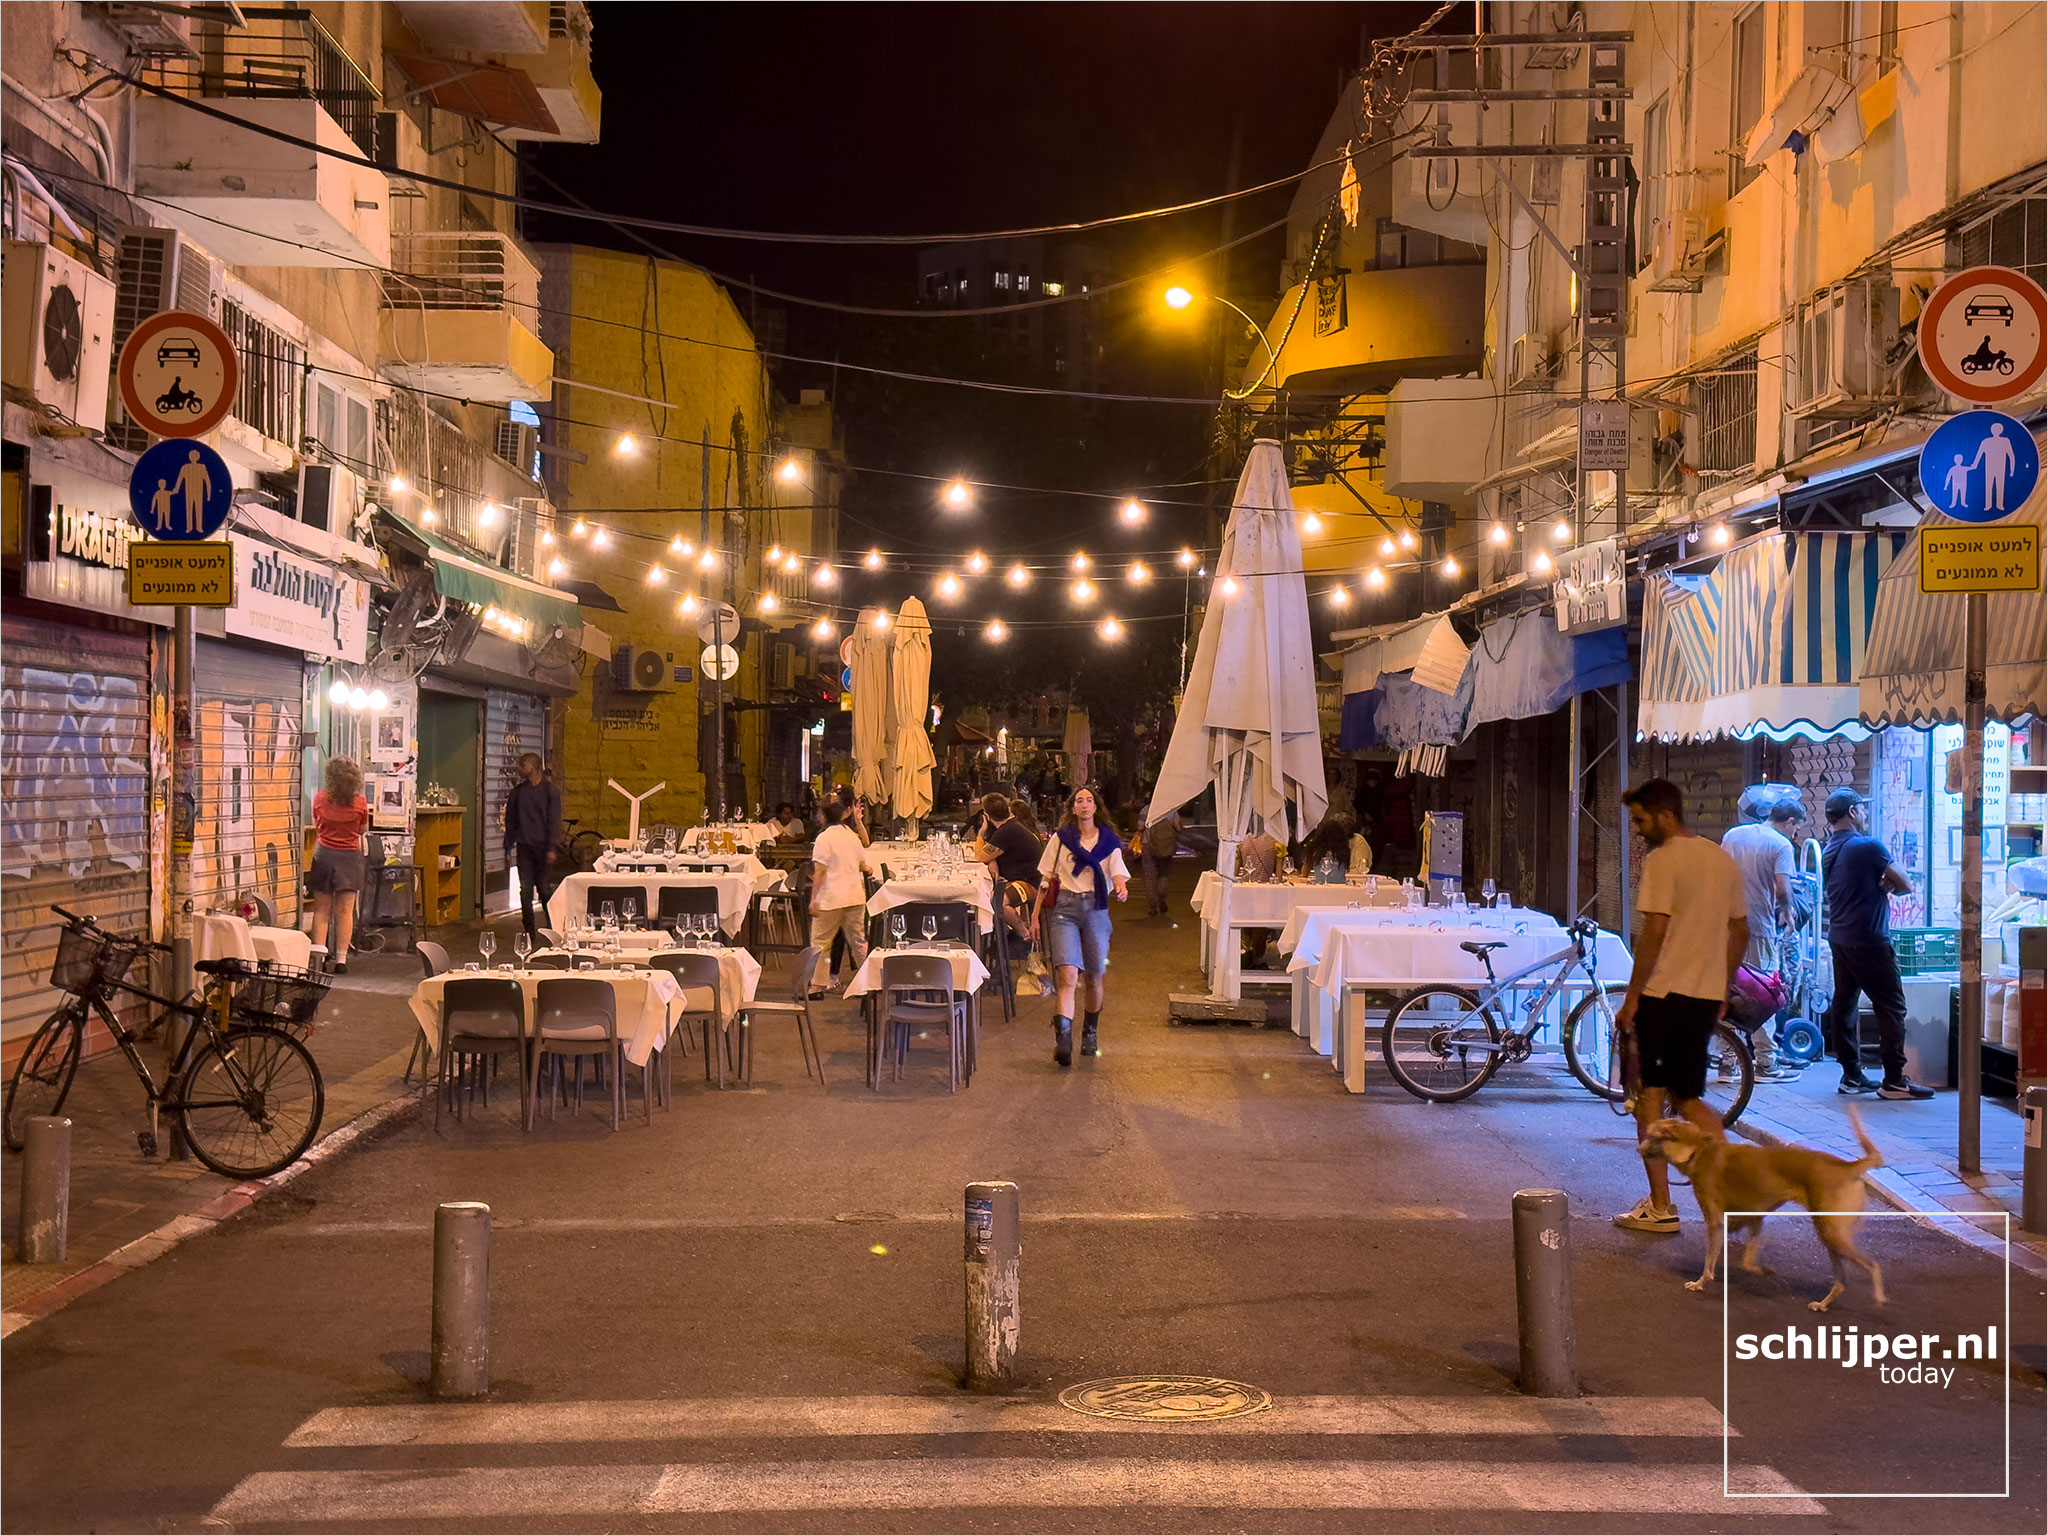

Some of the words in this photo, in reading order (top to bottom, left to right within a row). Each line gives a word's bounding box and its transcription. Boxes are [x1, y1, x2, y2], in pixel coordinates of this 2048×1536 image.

[1928, 541, 1983, 554] אופניים
[1989, 537, 2032, 553] למעט
[136, 558, 183, 569] אופניים
[188, 555, 225, 569] למעט
[1936, 567, 1998, 580] ממונעים
[2004, 564, 2024, 578] לא
[143, 583, 196, 594] ממונעים
[201, 580, 219, 593] לא
